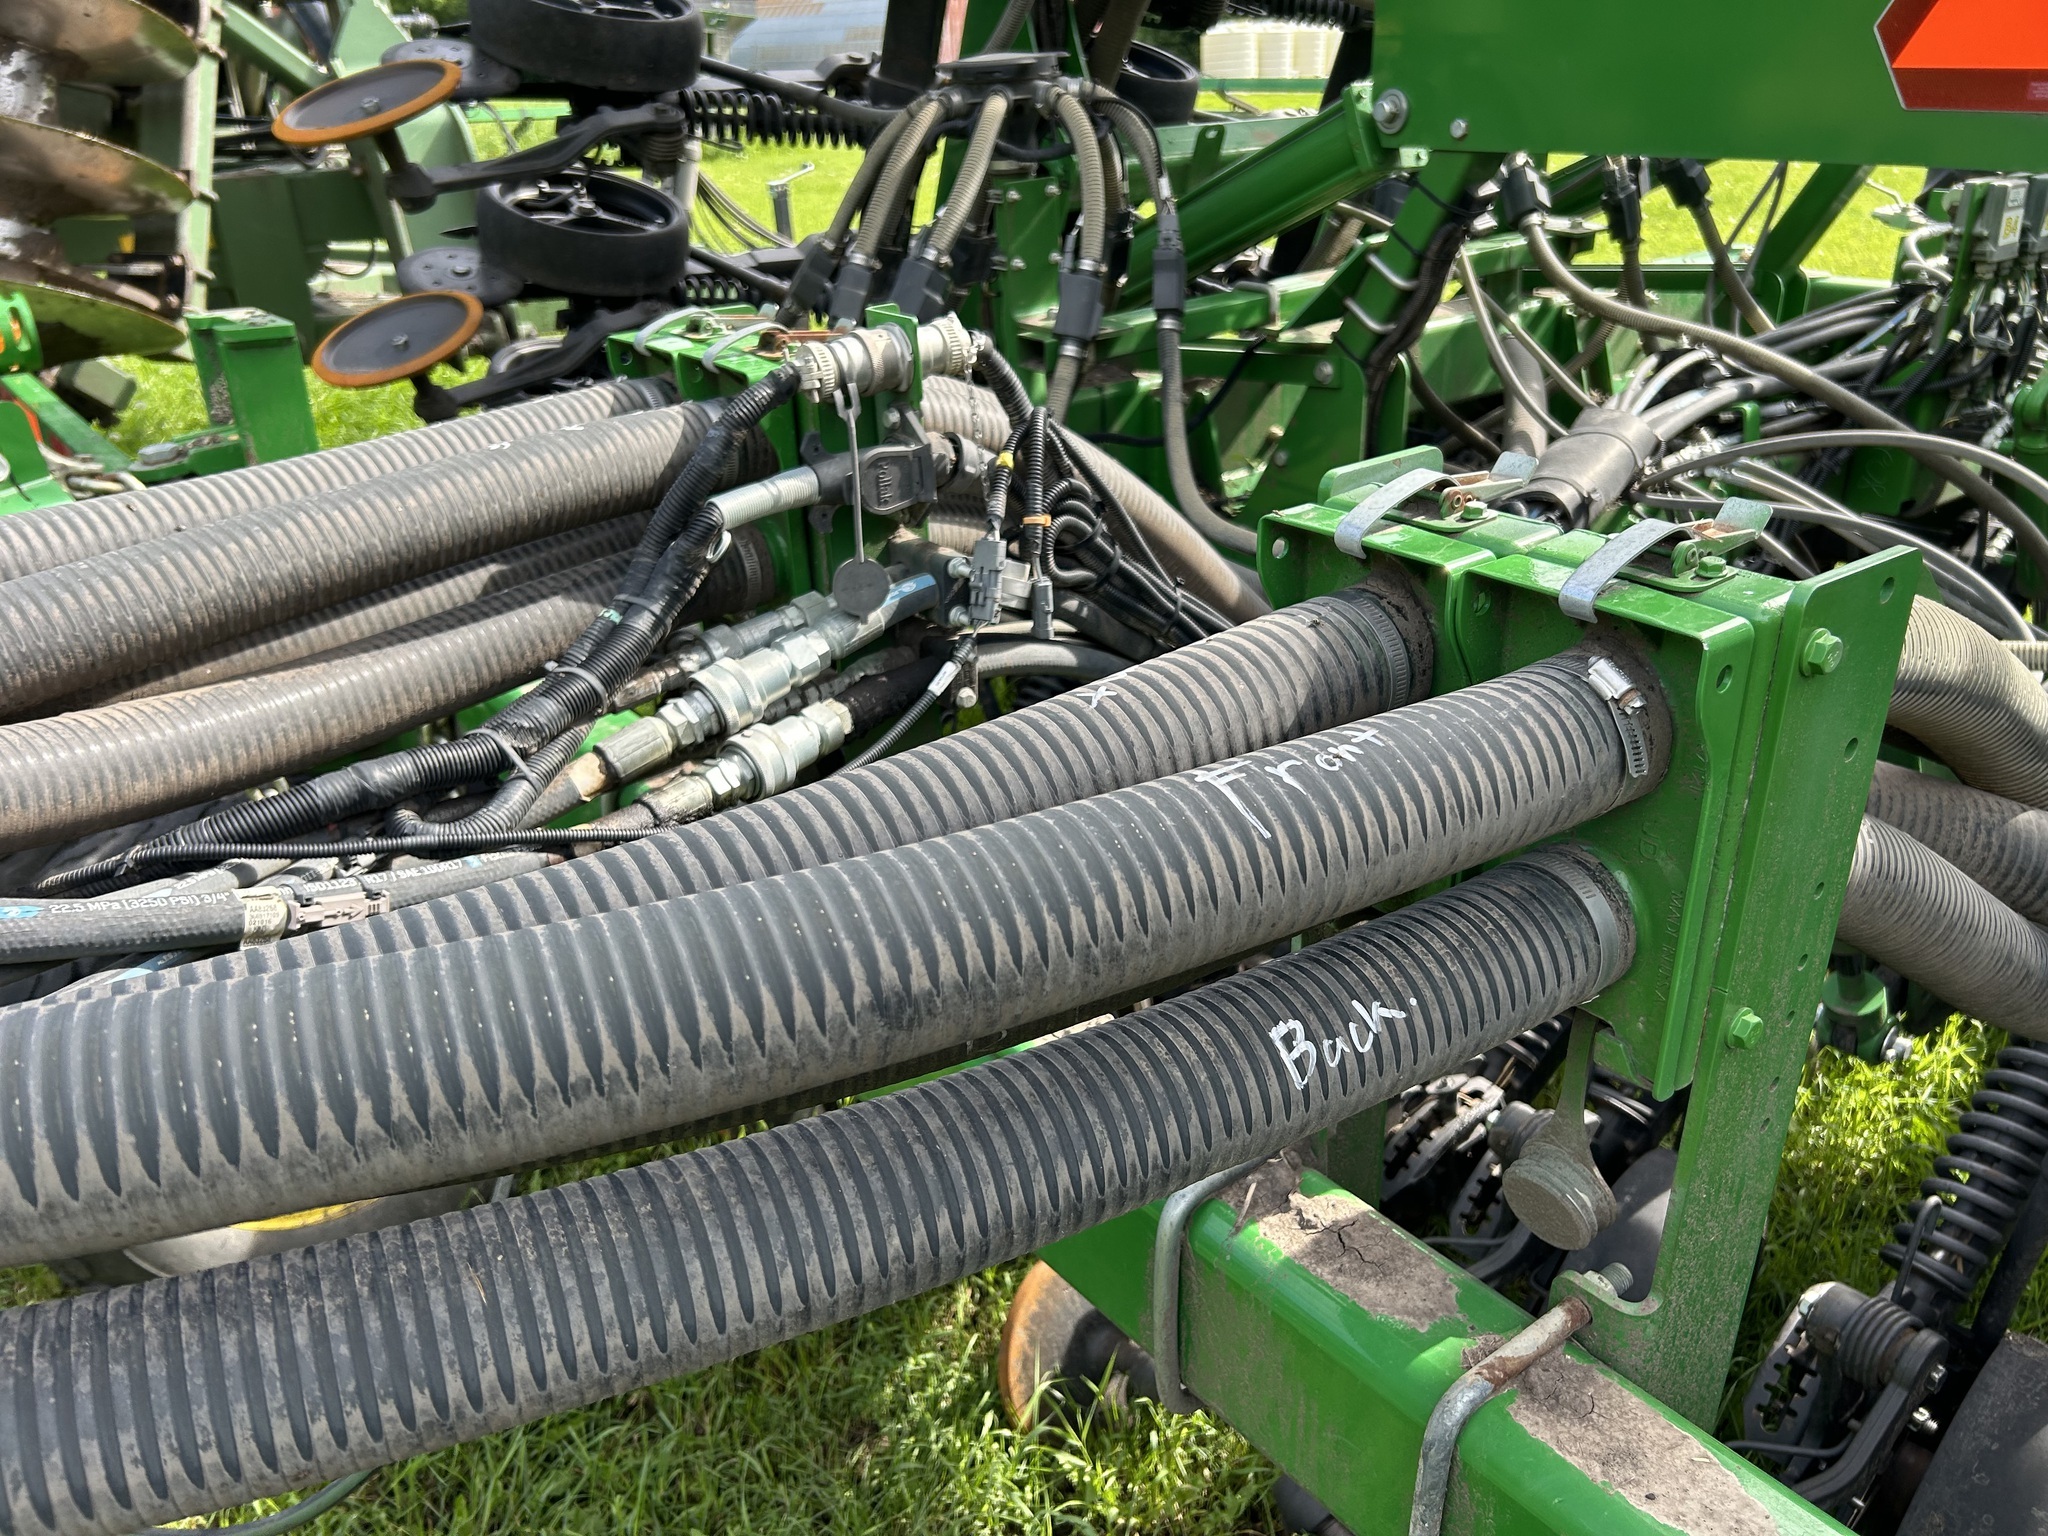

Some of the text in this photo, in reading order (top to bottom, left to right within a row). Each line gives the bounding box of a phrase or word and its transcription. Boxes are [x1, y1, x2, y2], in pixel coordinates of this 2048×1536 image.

[1194, 729, 1386, 840] Front
[48, 902, 86, 915] 22.5
[86, 901, 122, 912] MPa
